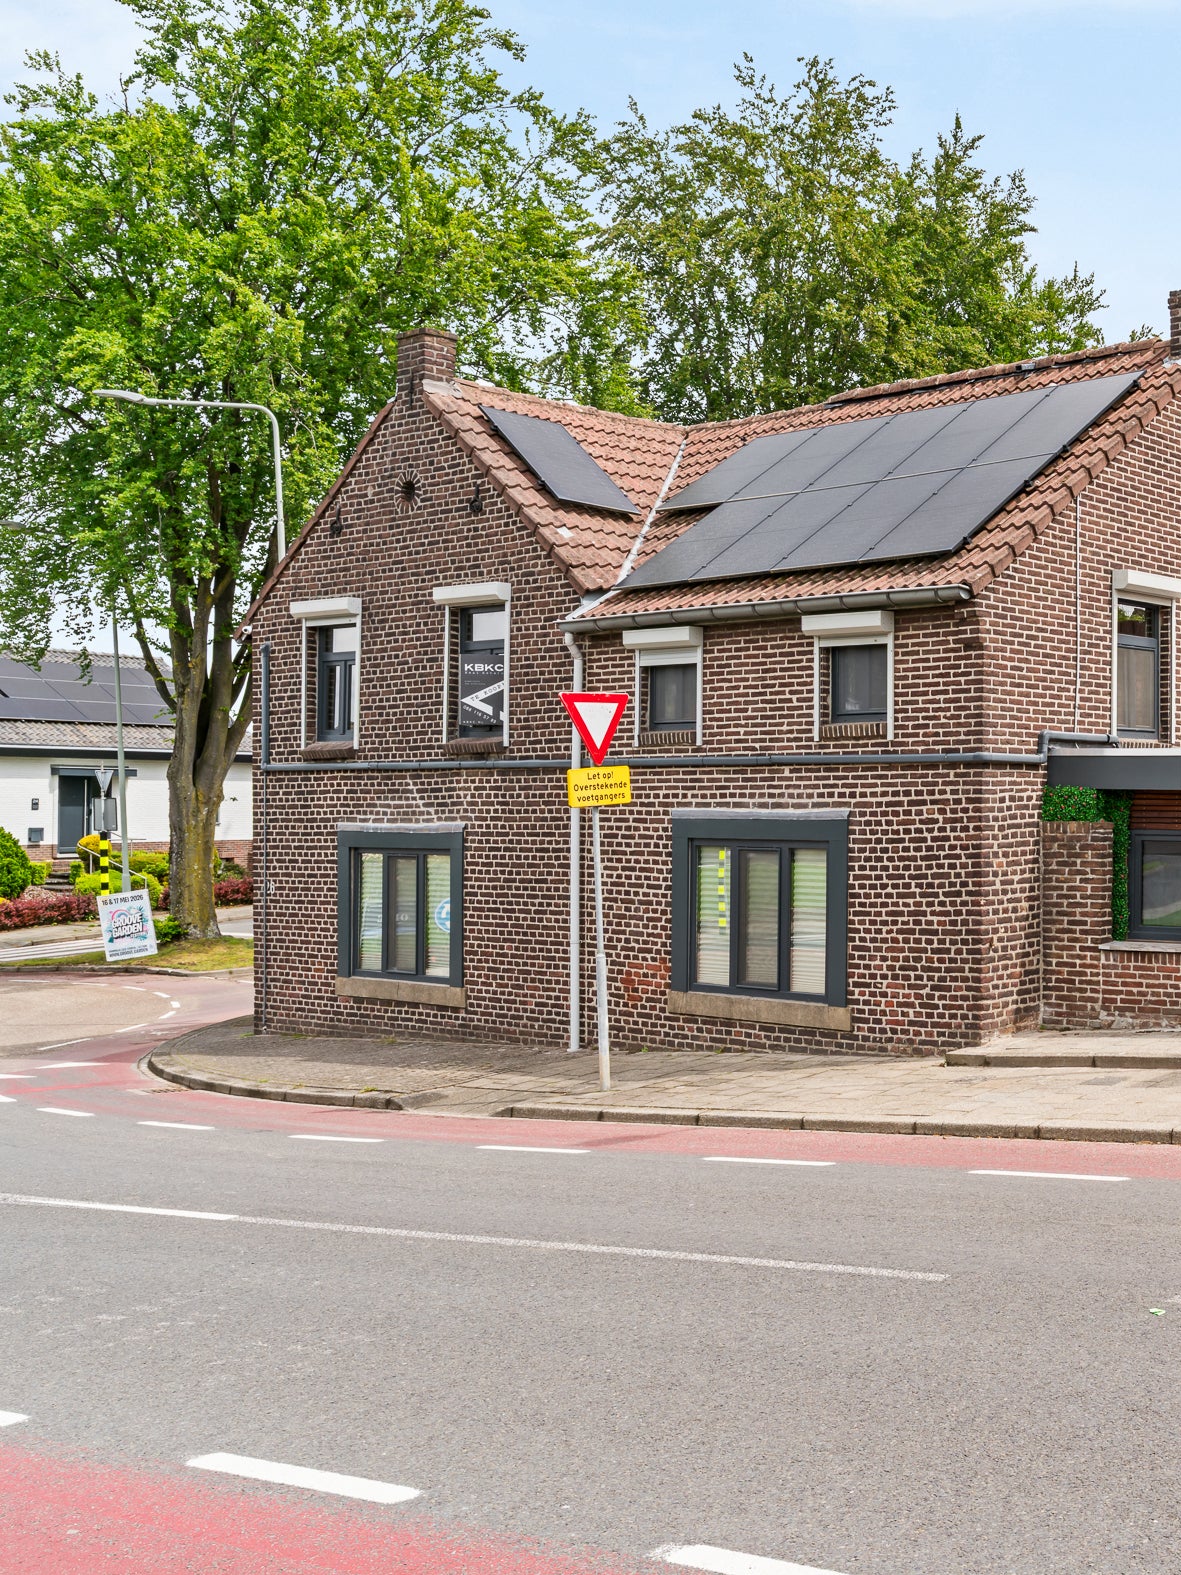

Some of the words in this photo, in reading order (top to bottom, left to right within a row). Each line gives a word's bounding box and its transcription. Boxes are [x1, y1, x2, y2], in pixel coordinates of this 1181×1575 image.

[587, 772, 600, 780] Let
[602, 771, 614, 780] op!
[573, 781, 628, 791] Overstekende
[576, 792, 626, 803] voetgangers
[113, 897, 119, 905] 17
[112, 912, 143, 927] GROOVE
[112, 922, 143, 938] GARDEN
